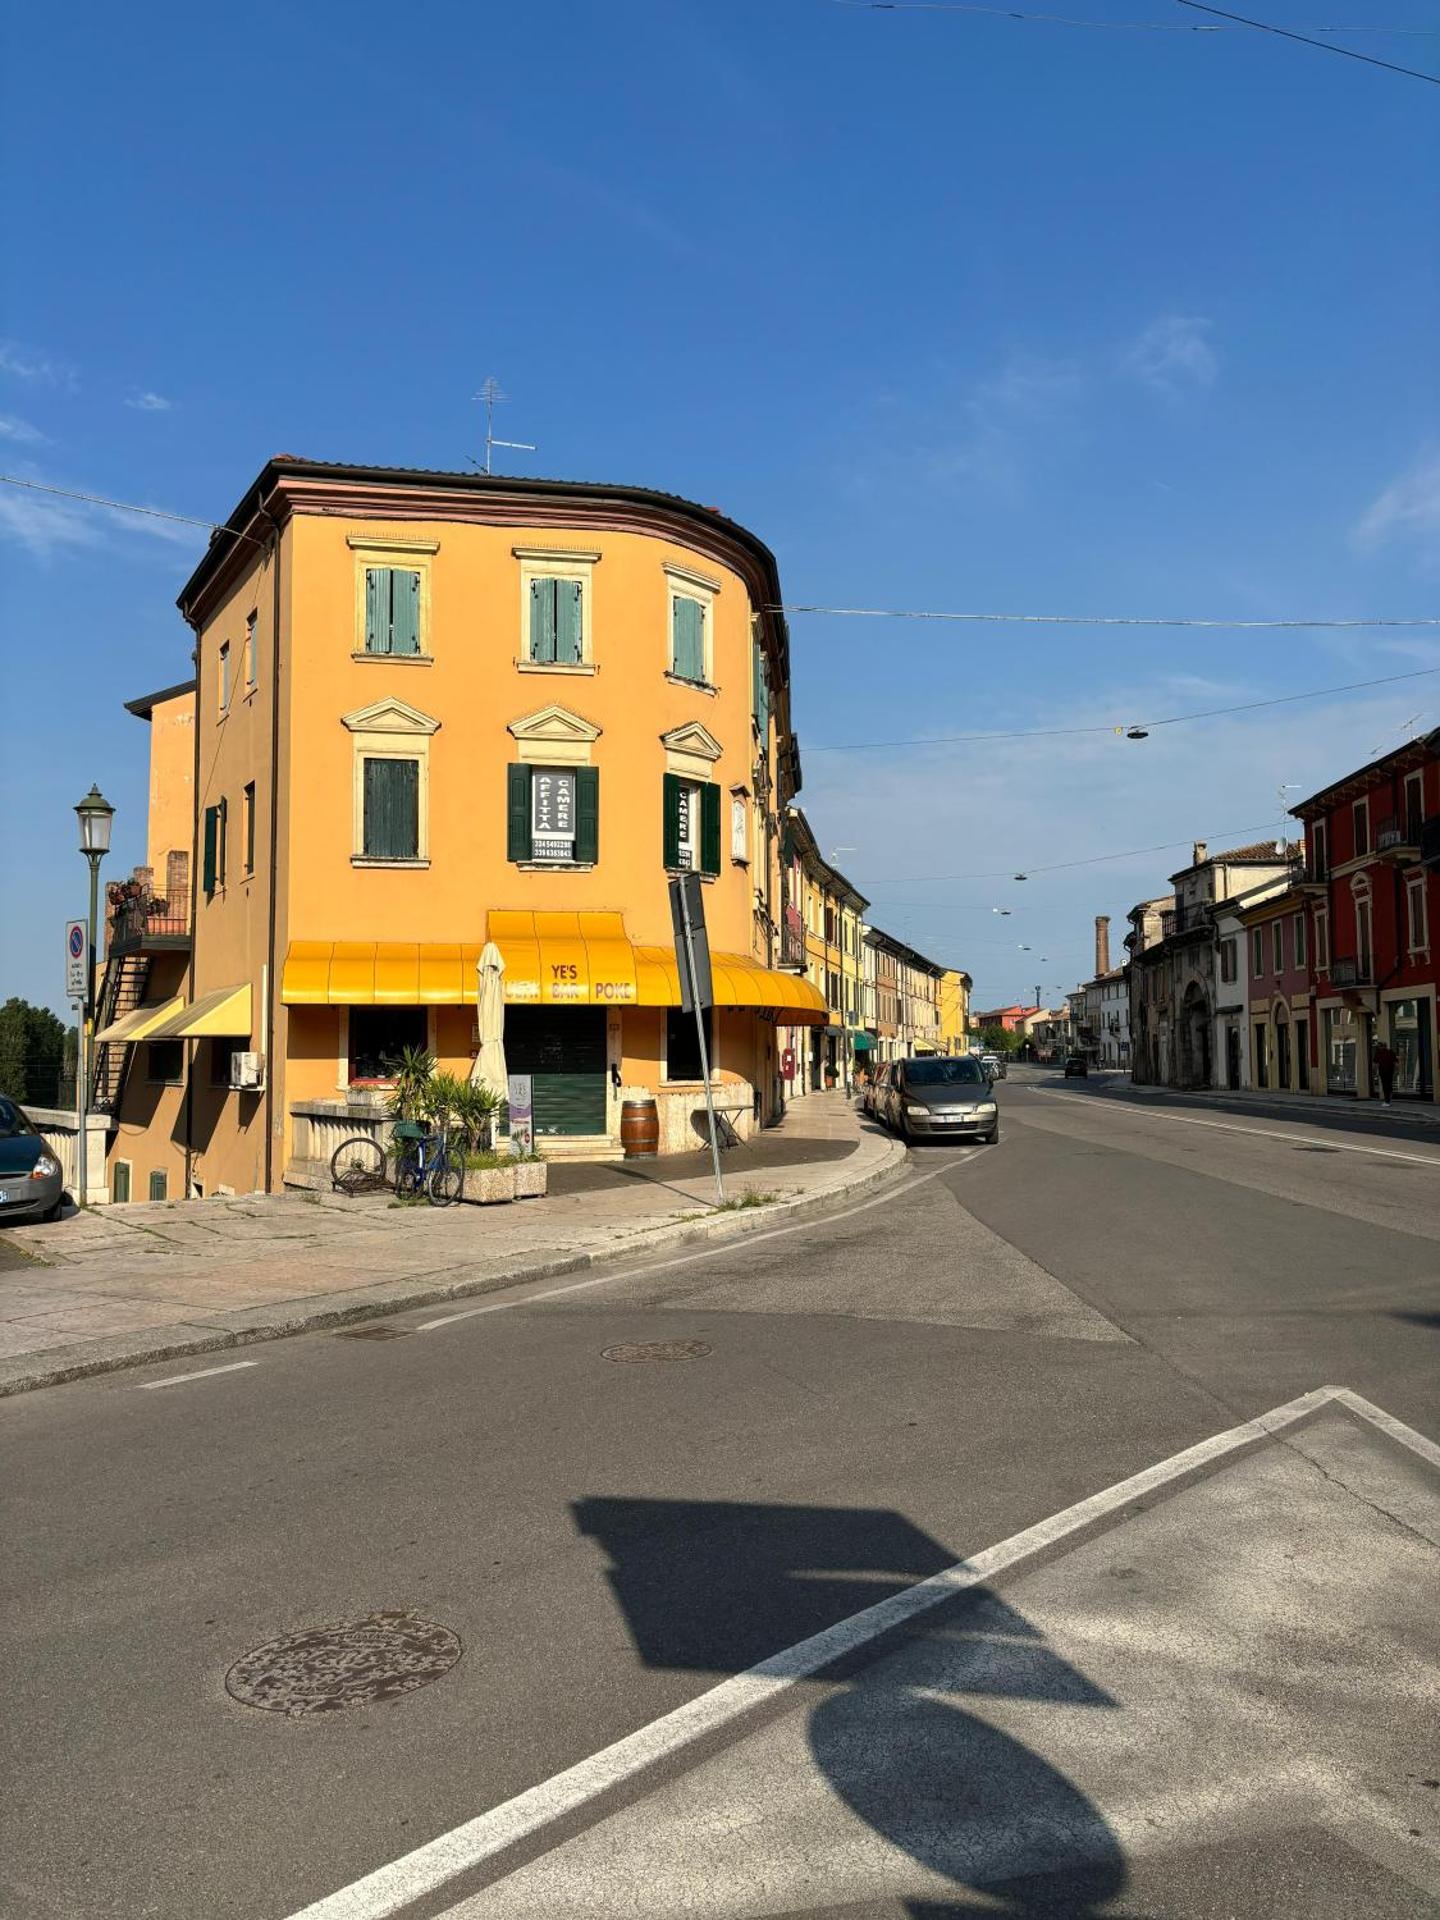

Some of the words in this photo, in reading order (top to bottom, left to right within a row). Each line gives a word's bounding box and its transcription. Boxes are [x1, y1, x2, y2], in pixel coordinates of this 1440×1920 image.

[538, 777, 551, 830] AFFITTA
[556, 780, 570, 828] CAMERE
[679, 792, 688, 838] CAMERE
[551, 965, 578, 979] YE'S
[552, 983, 580, 998] BAR
[595, 983, 631, 999] POKE
